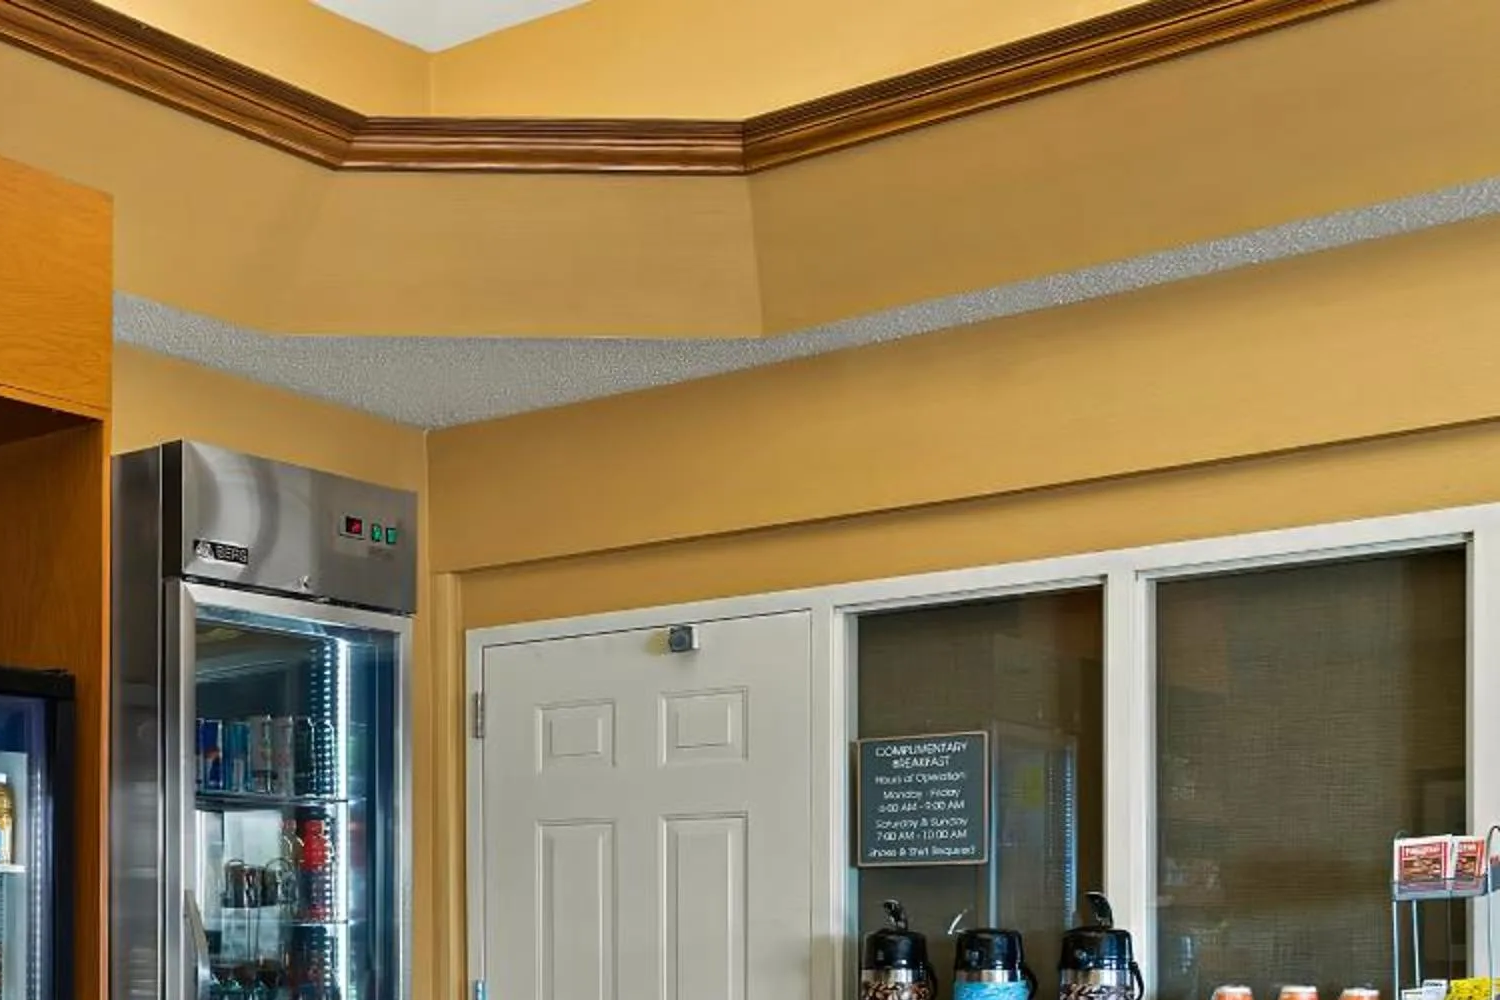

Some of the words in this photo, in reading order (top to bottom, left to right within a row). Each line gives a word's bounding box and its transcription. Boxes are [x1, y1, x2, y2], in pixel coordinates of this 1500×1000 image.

[892, 755, 951, 769] BREAKFAST
[948, 800, 966, 810] AM
[950, 828, 968, 839] AM
